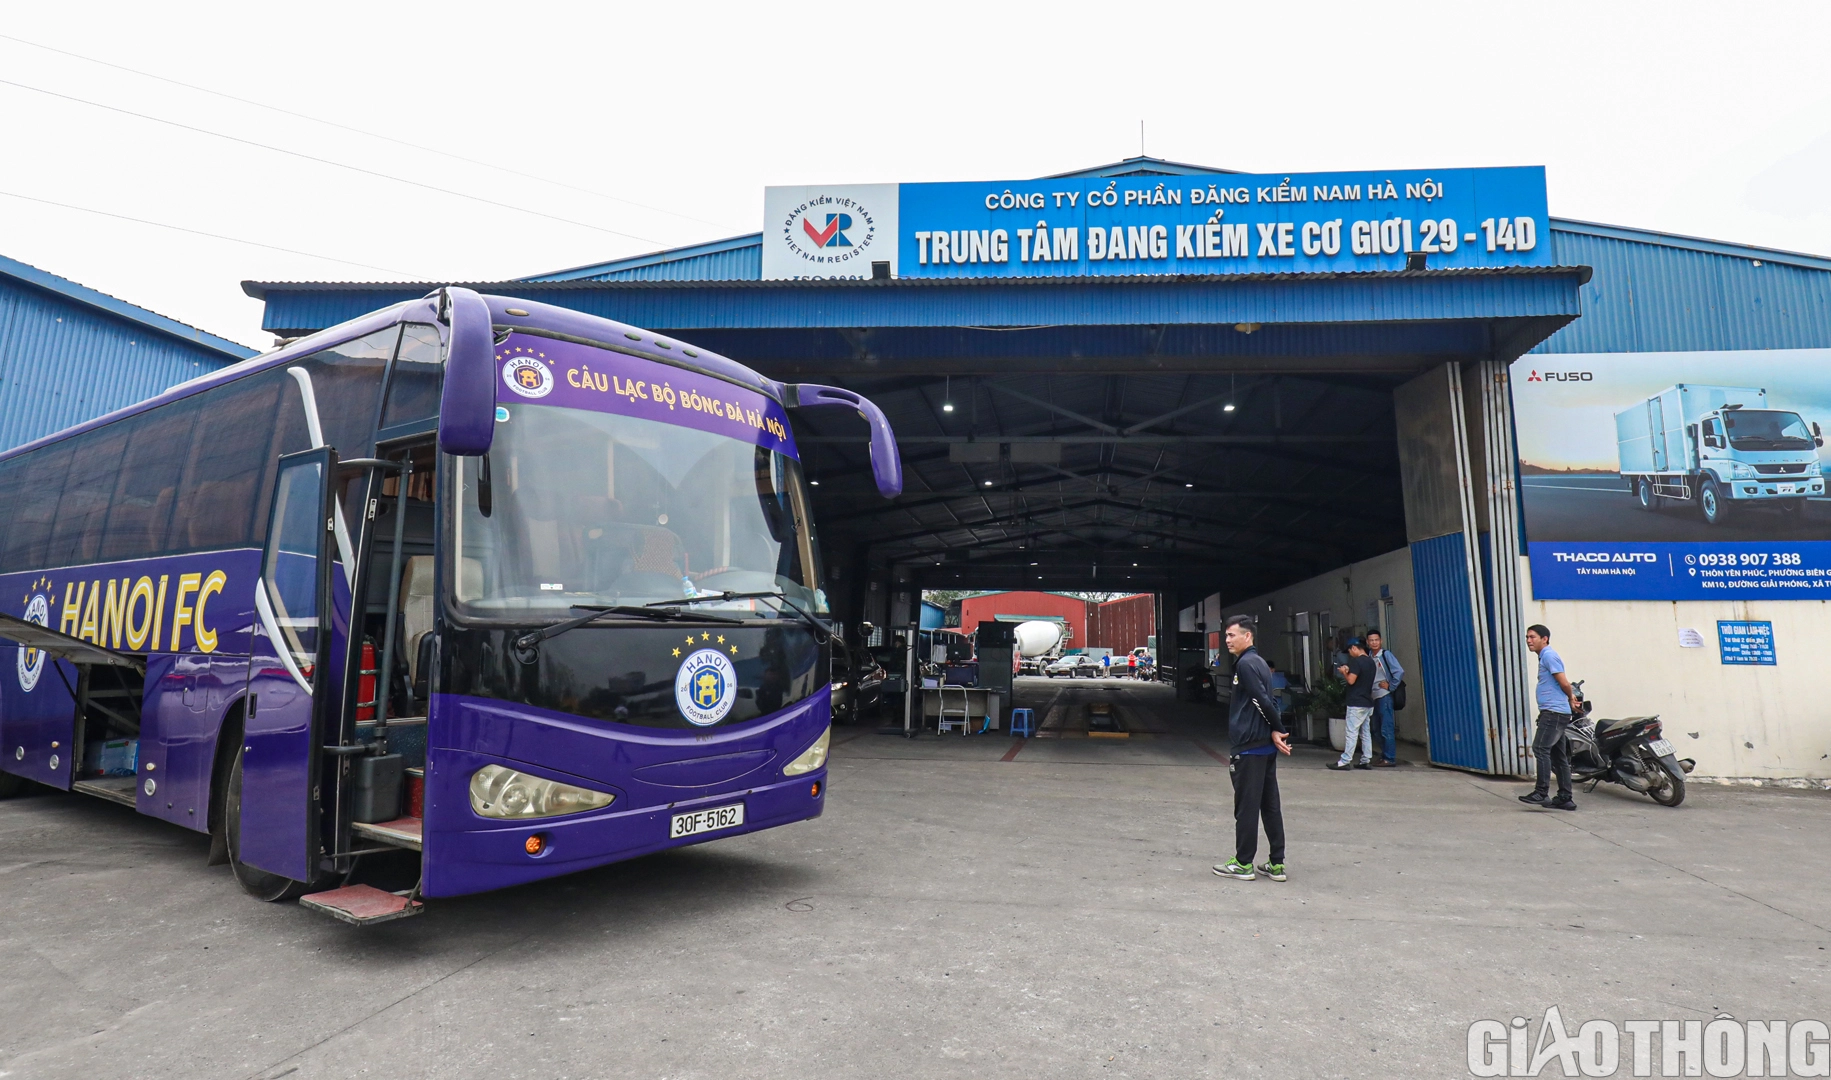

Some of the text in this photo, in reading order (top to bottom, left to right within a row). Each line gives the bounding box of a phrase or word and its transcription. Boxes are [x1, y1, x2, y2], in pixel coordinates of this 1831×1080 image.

[985, 177, 1443, 209] CÔNG TY CỔ PHẦN ĐĂNG KIỂM NAM HÀ NỘI
[785, 195, 874, 226] ĐĂNG KIỂM VIỆT NAM
[915, 228, 1009, 264] TRUNG
[1016, 219, 1079, 262] TÂM
[1176, 208, 1249, 259] KIỂM
[1256, 222, 1295, 257] XE
[1301, 218, 1343, 256] CƠ
[1419, 218, 1458, 253] 29
[1481, 216, 1537, 252] 14D
[827, 233, 874, 263] REGISTER
[509, 359, 544, 370] HANOI
[1544, 371, 1593, 382] FUSO
[567, 364, 787, 442] CÂU LẠC BỘ BÓNG ĐÁ HÀ NỘI
[1552, 552, 1657, 562] THACO AUTO
[1699, 552, 1801, 566] 0938 907 388
[1576, 567, 1591, 575] TÂY
[1610, 567, 1621, 575] HÀ
[1622, 567, 1636, 576] NỘI
[1700, 568, 1724, 577] THÔN
[1724, 568, 1741, 577] YÊN
[1768, 567, 1804, 577] PHƯỜNG
[1805, 567, 1825, 576] BIÊN
[1701, 581, 1727, 589] KM10,
[1728, 579, 1760, 588] ĐƯỜNG
[60, 569, 227, 654] HANOI FC
[686, 653, 727, 674] HANOI
[685, 705, 714, 720] FOOTBALL
[675, 807, 737, 835] 30F-5162
